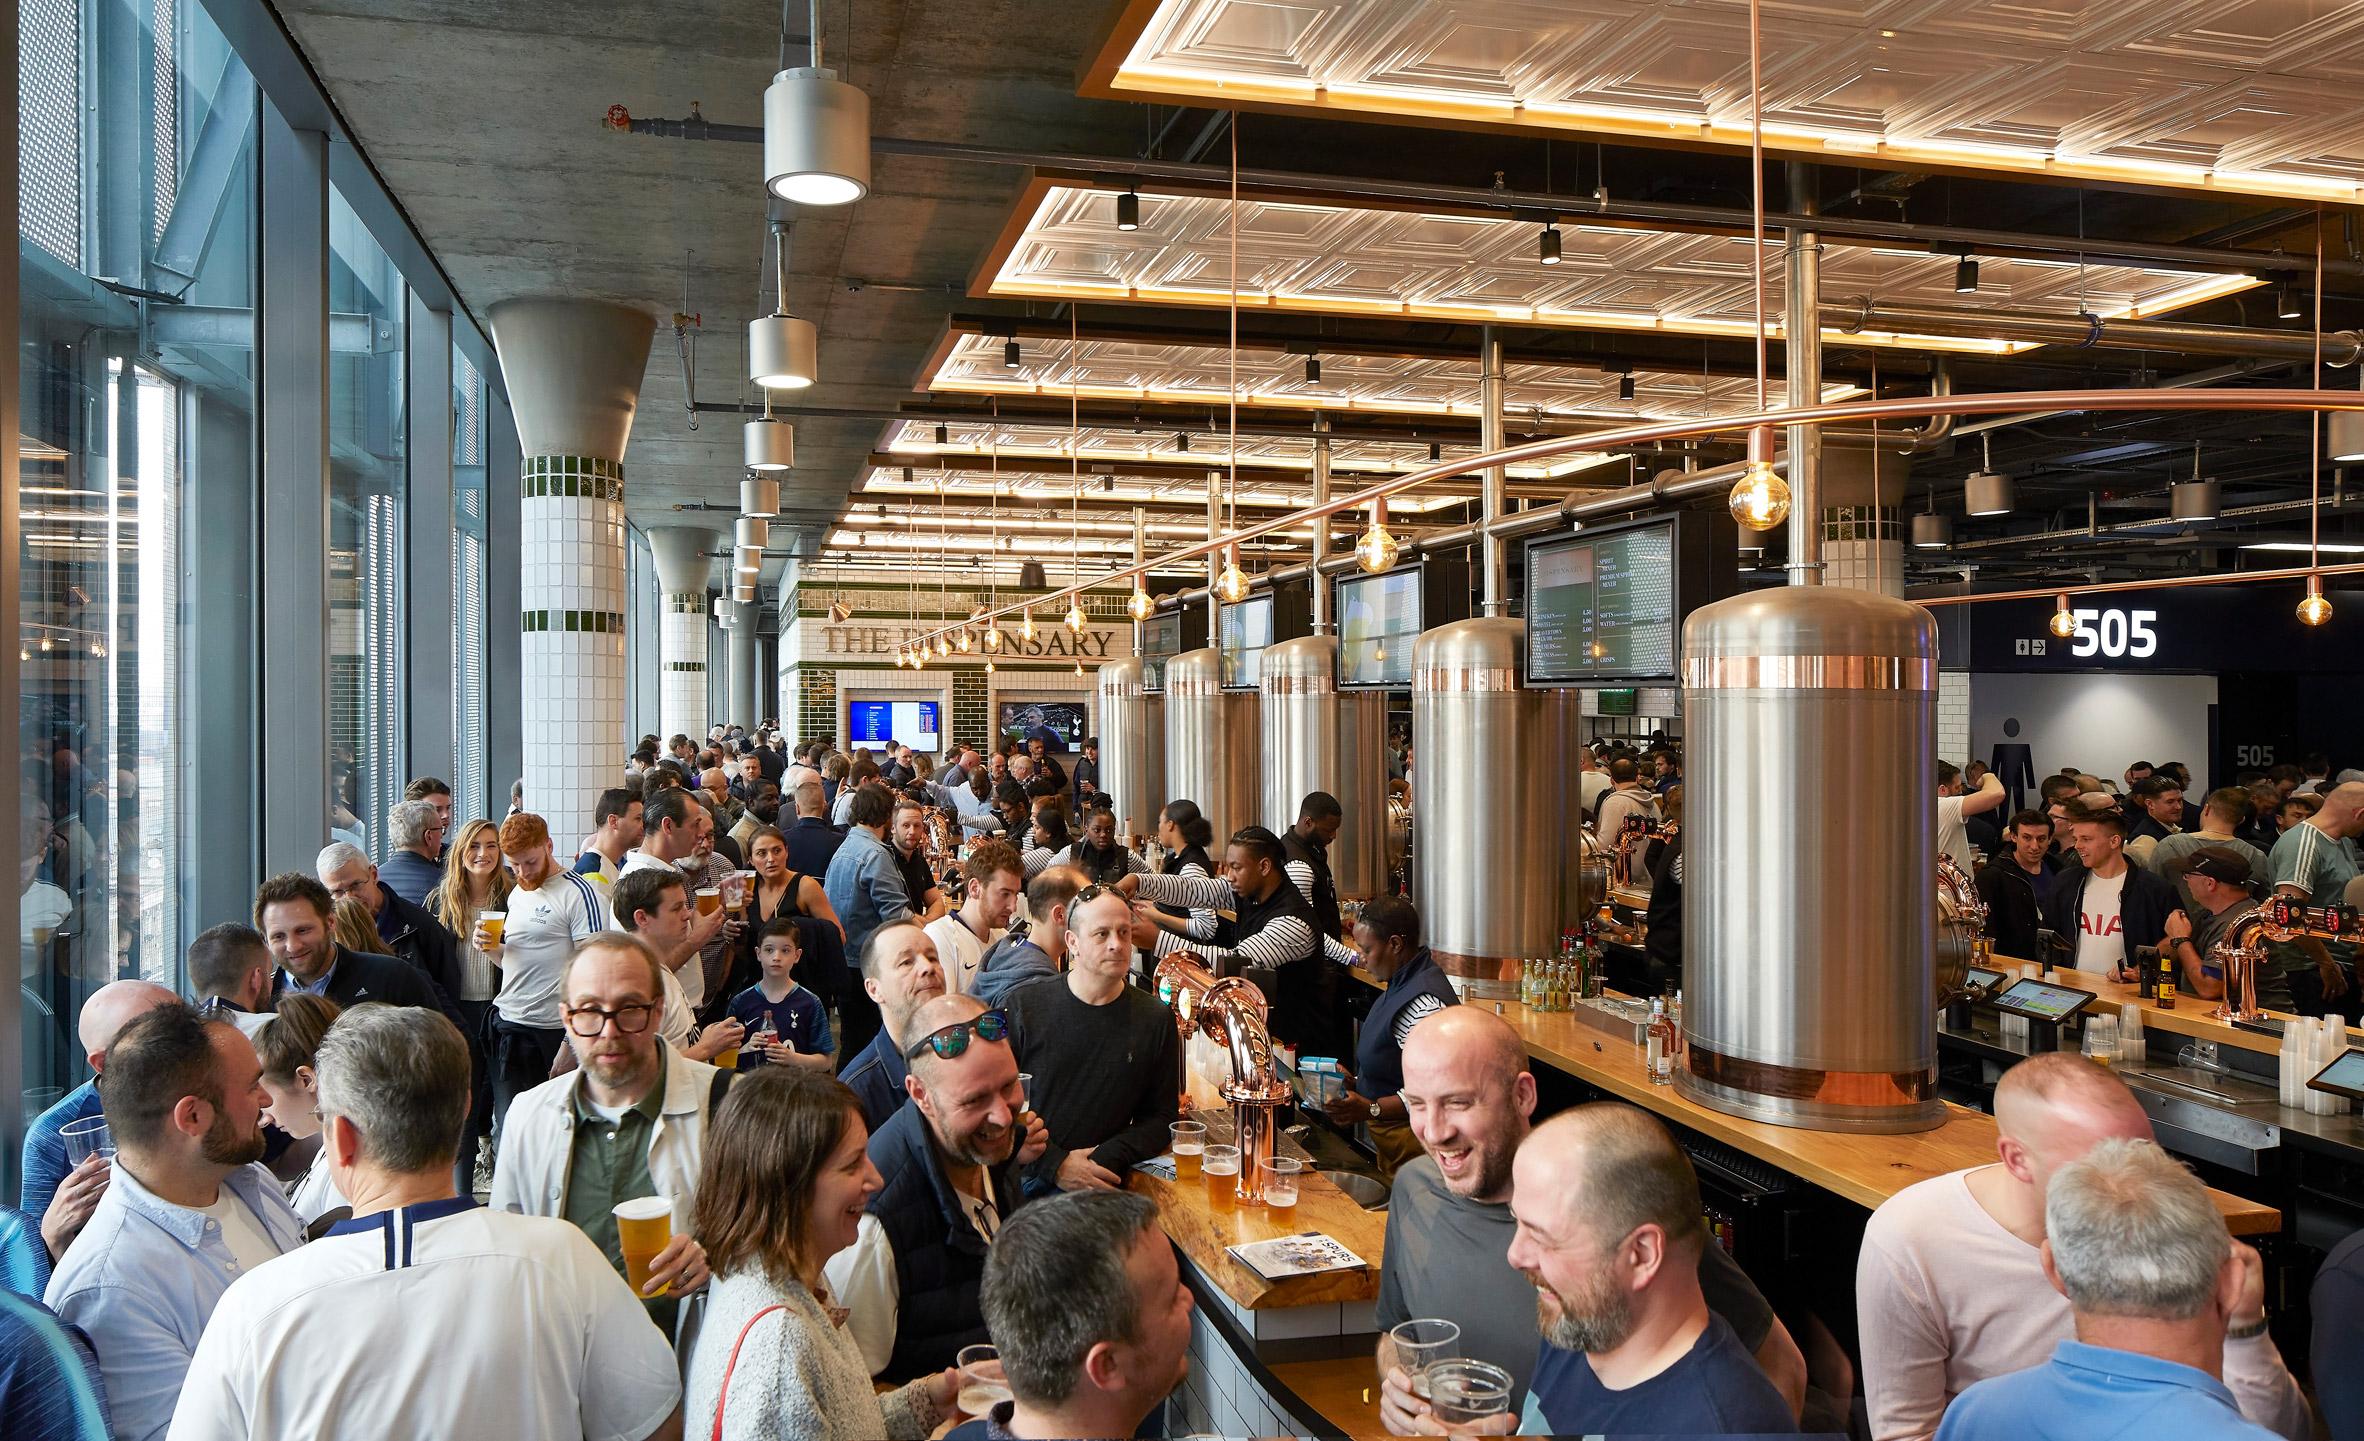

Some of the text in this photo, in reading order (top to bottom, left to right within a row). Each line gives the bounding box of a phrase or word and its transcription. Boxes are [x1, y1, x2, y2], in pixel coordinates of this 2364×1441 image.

[820, 626, 891, 653] THE
[2072, 608, 2157, 658] 505
[2236, 744, 2274, 767] 505
[2080, 911, 2122, 937] AIA
[1321, 1241, 1355, 1263] SPURS
